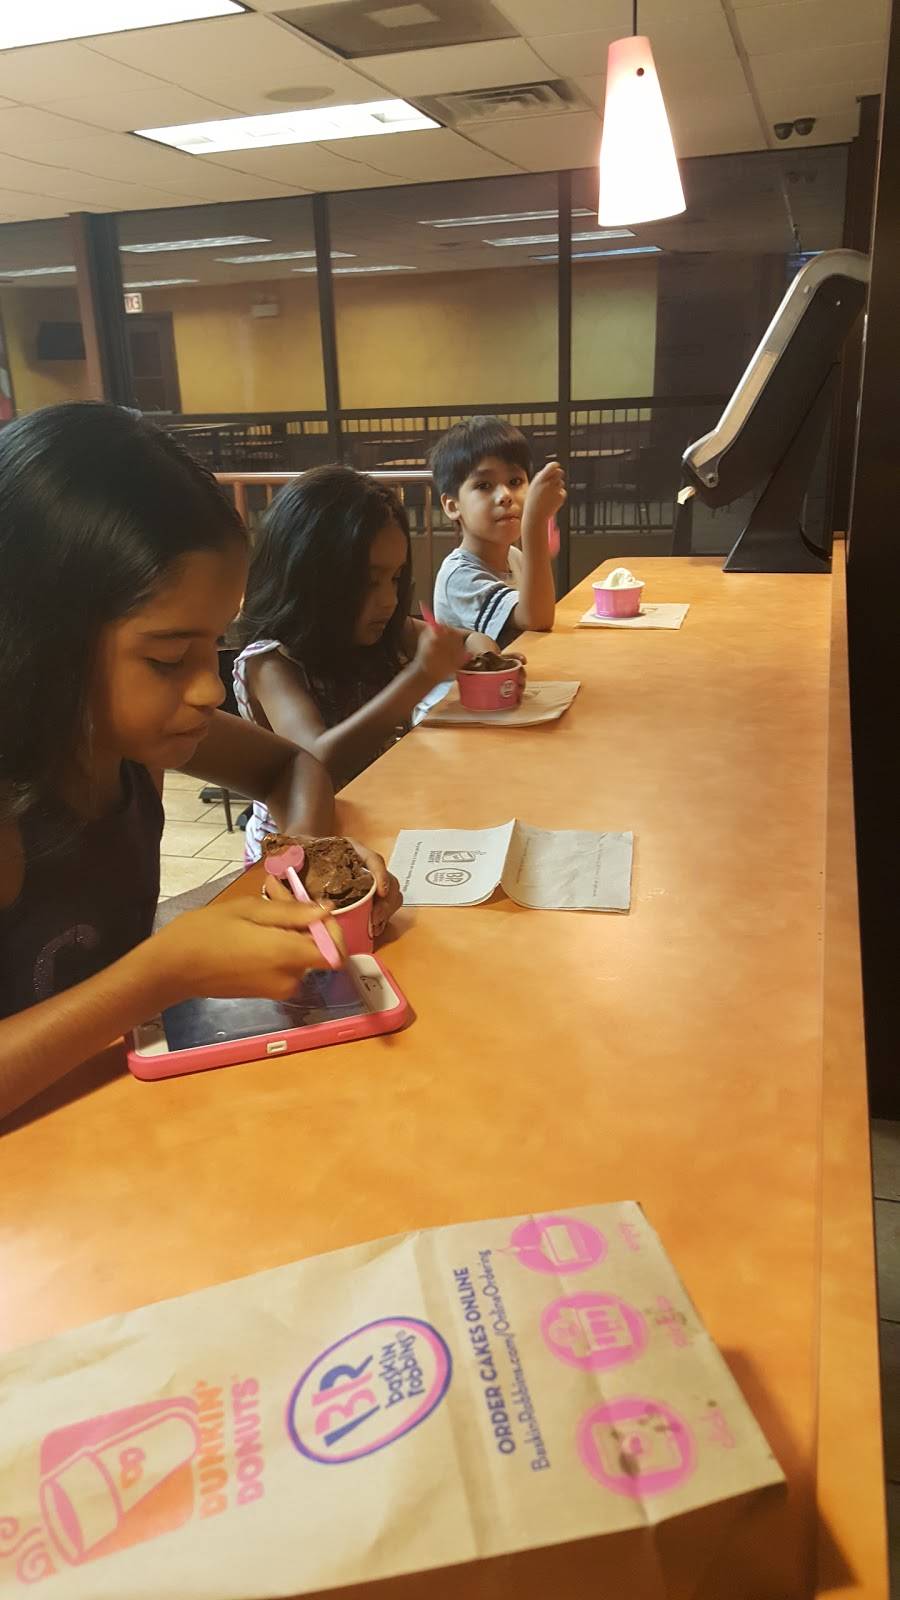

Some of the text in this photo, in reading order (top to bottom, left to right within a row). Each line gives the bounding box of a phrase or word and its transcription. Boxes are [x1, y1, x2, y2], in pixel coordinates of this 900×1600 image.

[453, 1266, 516, 1455] ORDER CAKES ONLINE
[230, 1376, 265, 1506] DONUTS
